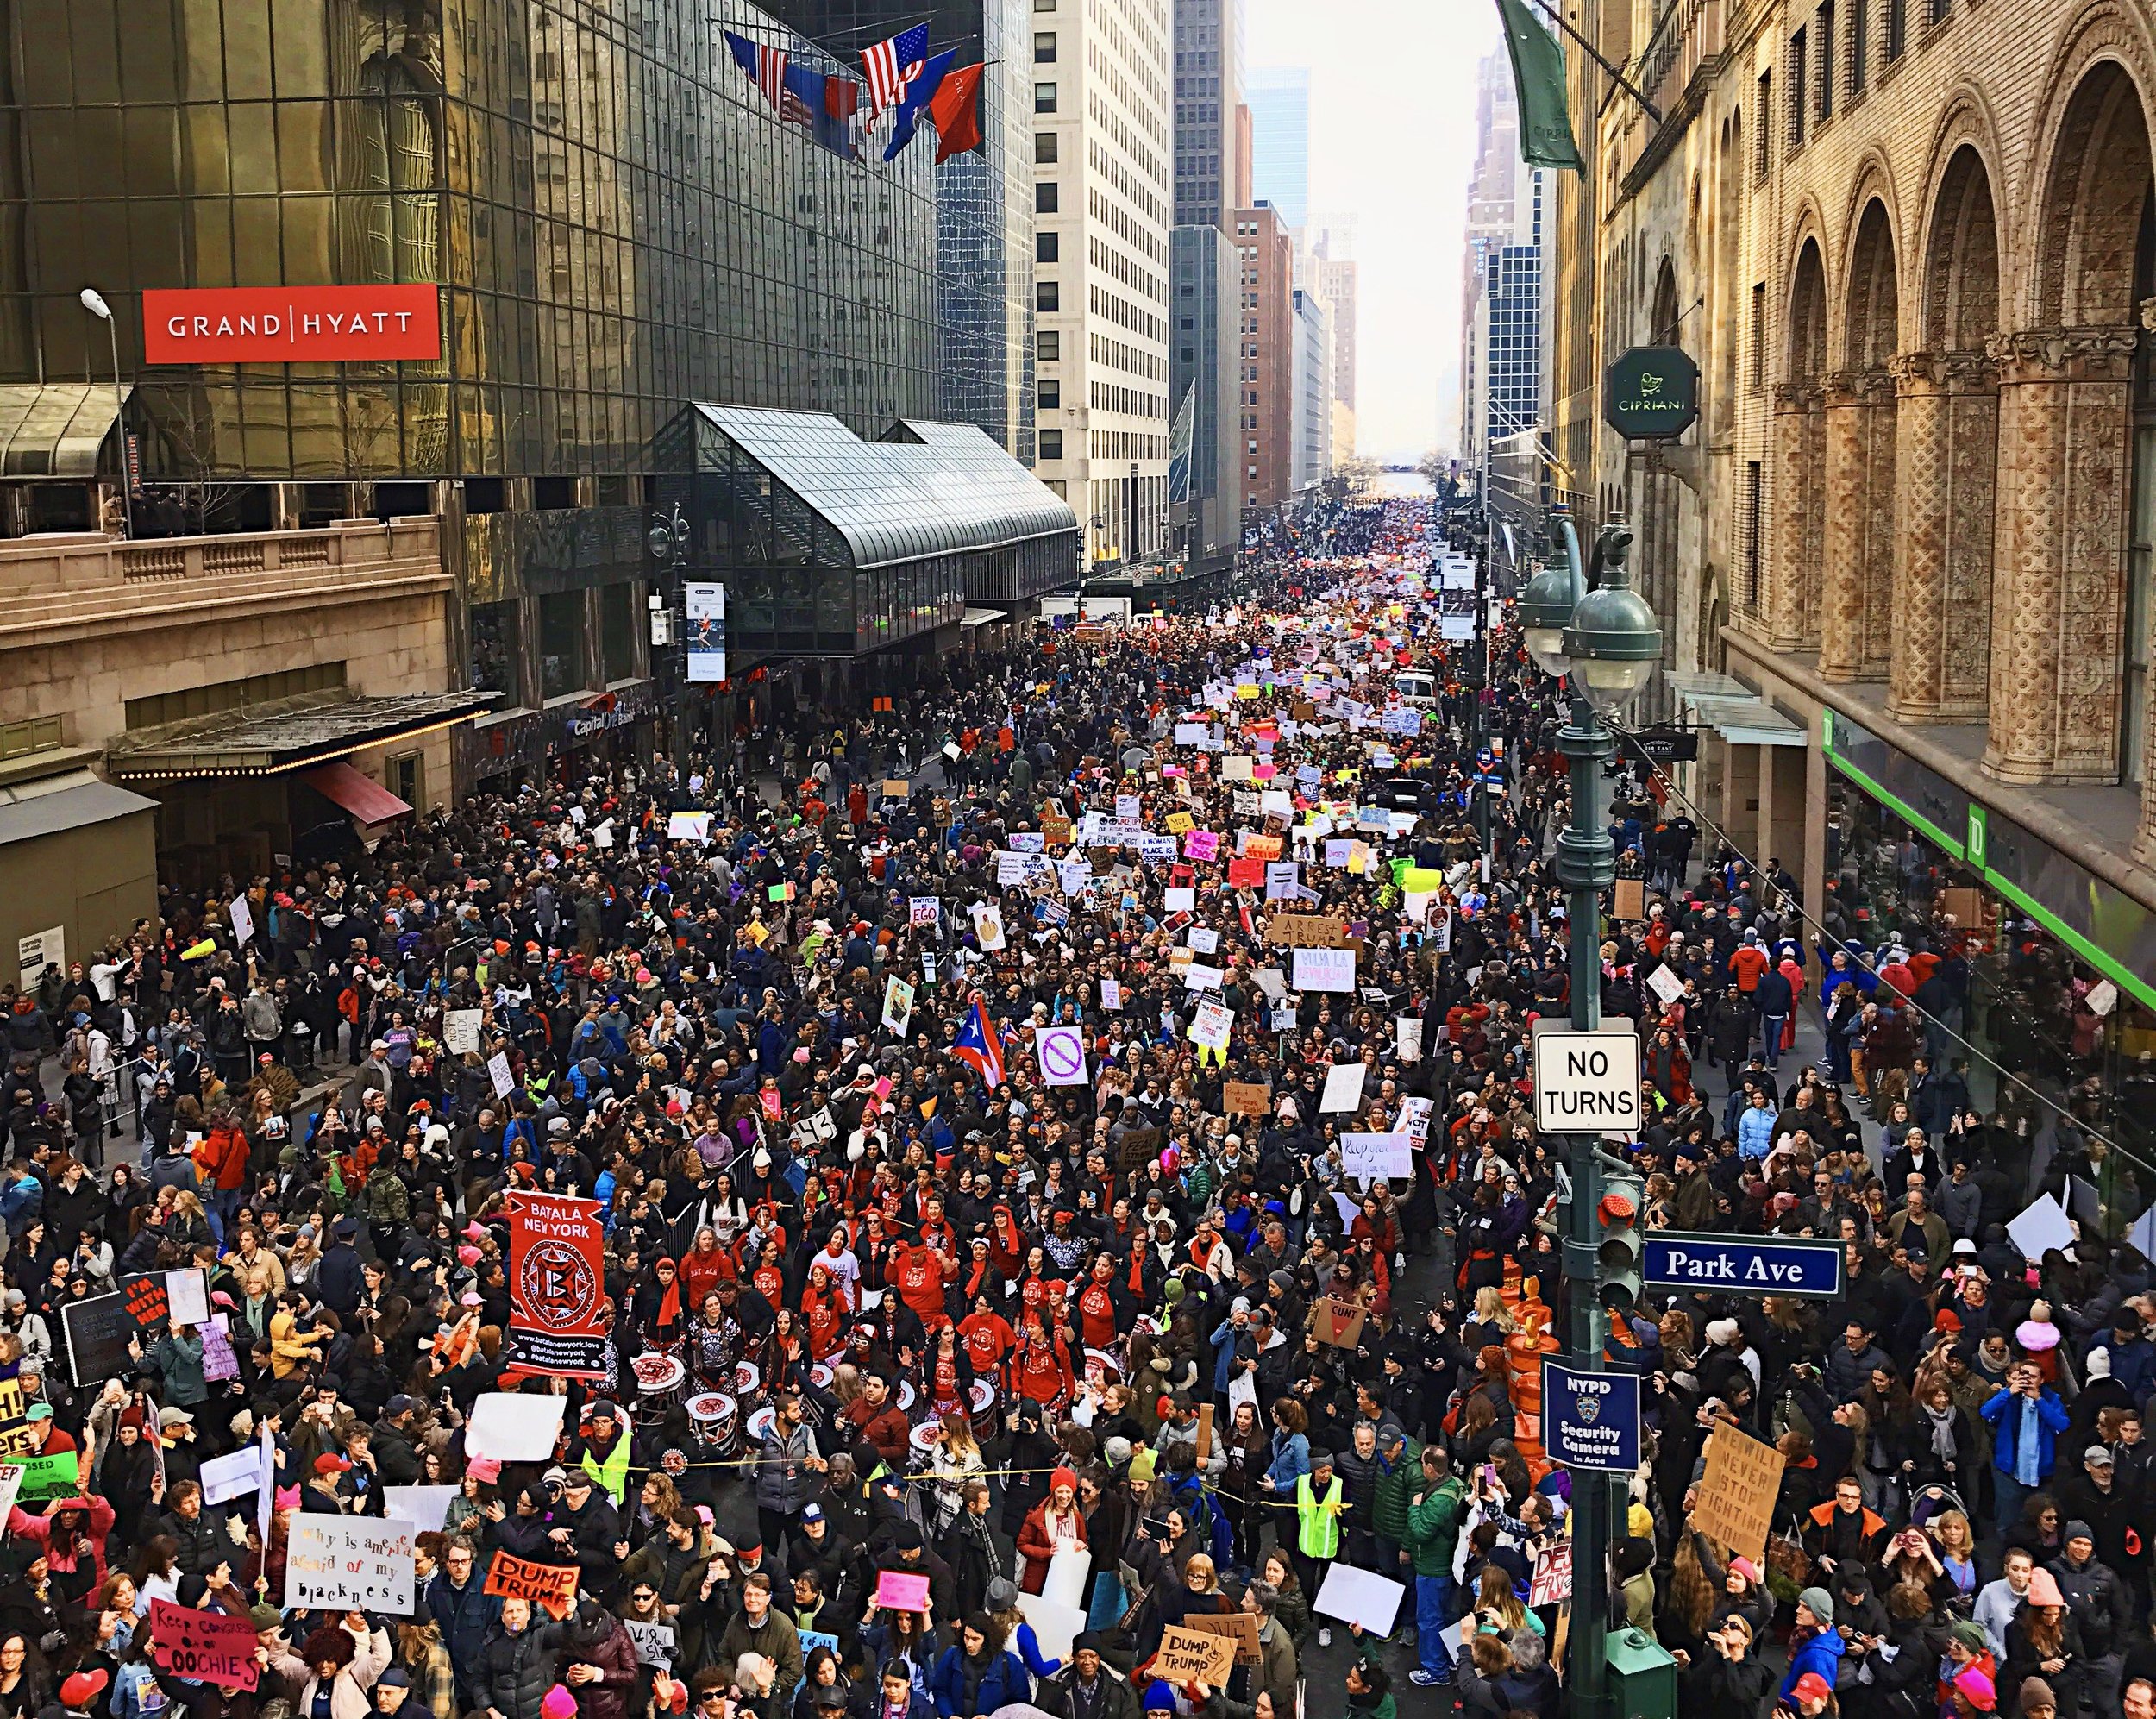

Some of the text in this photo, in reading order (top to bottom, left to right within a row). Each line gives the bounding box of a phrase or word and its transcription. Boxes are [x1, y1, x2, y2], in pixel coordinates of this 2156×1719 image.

[167, 312, 412, 337] GRAND HYATT
[1619, 400, 1684, 411] CIPRIANI
[574, 712, 604, 736] Capital
[1300, 782, 1317, 794] NO!
[914, 907, 937, 921] EGO
[1283, 931, 1336, 945] TRUMP
[1301, 952, 1348, 967] VULVA LA
[457, 1014, 468, 1050] DIVIDE
[470, 1022, 480, 1040] US
[1568, 1051, 1608, 1077] NO
[1545, 1090, 1633, 1114] TURNS
[1407, 1119, 1427, 1129] NOT
[1345, 1138, 1368, 1159] Keep
[1369, 1143, 1389, 1163] your
[530, 1202, 583, 1223] BATALÁ
[523, 1218, 590, 1239] NEW YORK
[1666, 1251, 1803, 1283] Park Ave
[125, 1286, 166, 1315] WITH
[1332, 1305, 1357, 1320] CUNT
[136, 1303, 167, 1326] HER
[1567, 1377, 1611, 1394] NYPD
[1560, 1421, 1620, 1443] Security
[1562, 1436, 1620, 1456] Camera
[1719, 1430, 1777, 1471] WE WILL
[1584, 1456, 1606, 1465] Area
[1721, 1452, 1768, 1490] NEVER
[0, 1466, 19, 1482] EP
[1719, 1474, 1758, 1507] STOP
[1700, 1488, 1767, 1540] FIGHTING
[302, 1528, 411, 1558] why is america
[1715, 1520, 1741, 1546] YOU
[290, 1554, 398, 1581] afraid of my
[499, 1558, 575, 1590] DUMP
[298, 1582, 404, 1605] blackness
[495, 1573, 570, 1605] TRUMP
[157, 1608, 190, 1633] Keep
[1169, 1636, 1209, 1654] DUMP
[1192, 1620, 1247, 1651] OVE
[154, 1641, 258, 1687] COOCHIES
[1163, 1653, 1209, 1674] TRUMP
